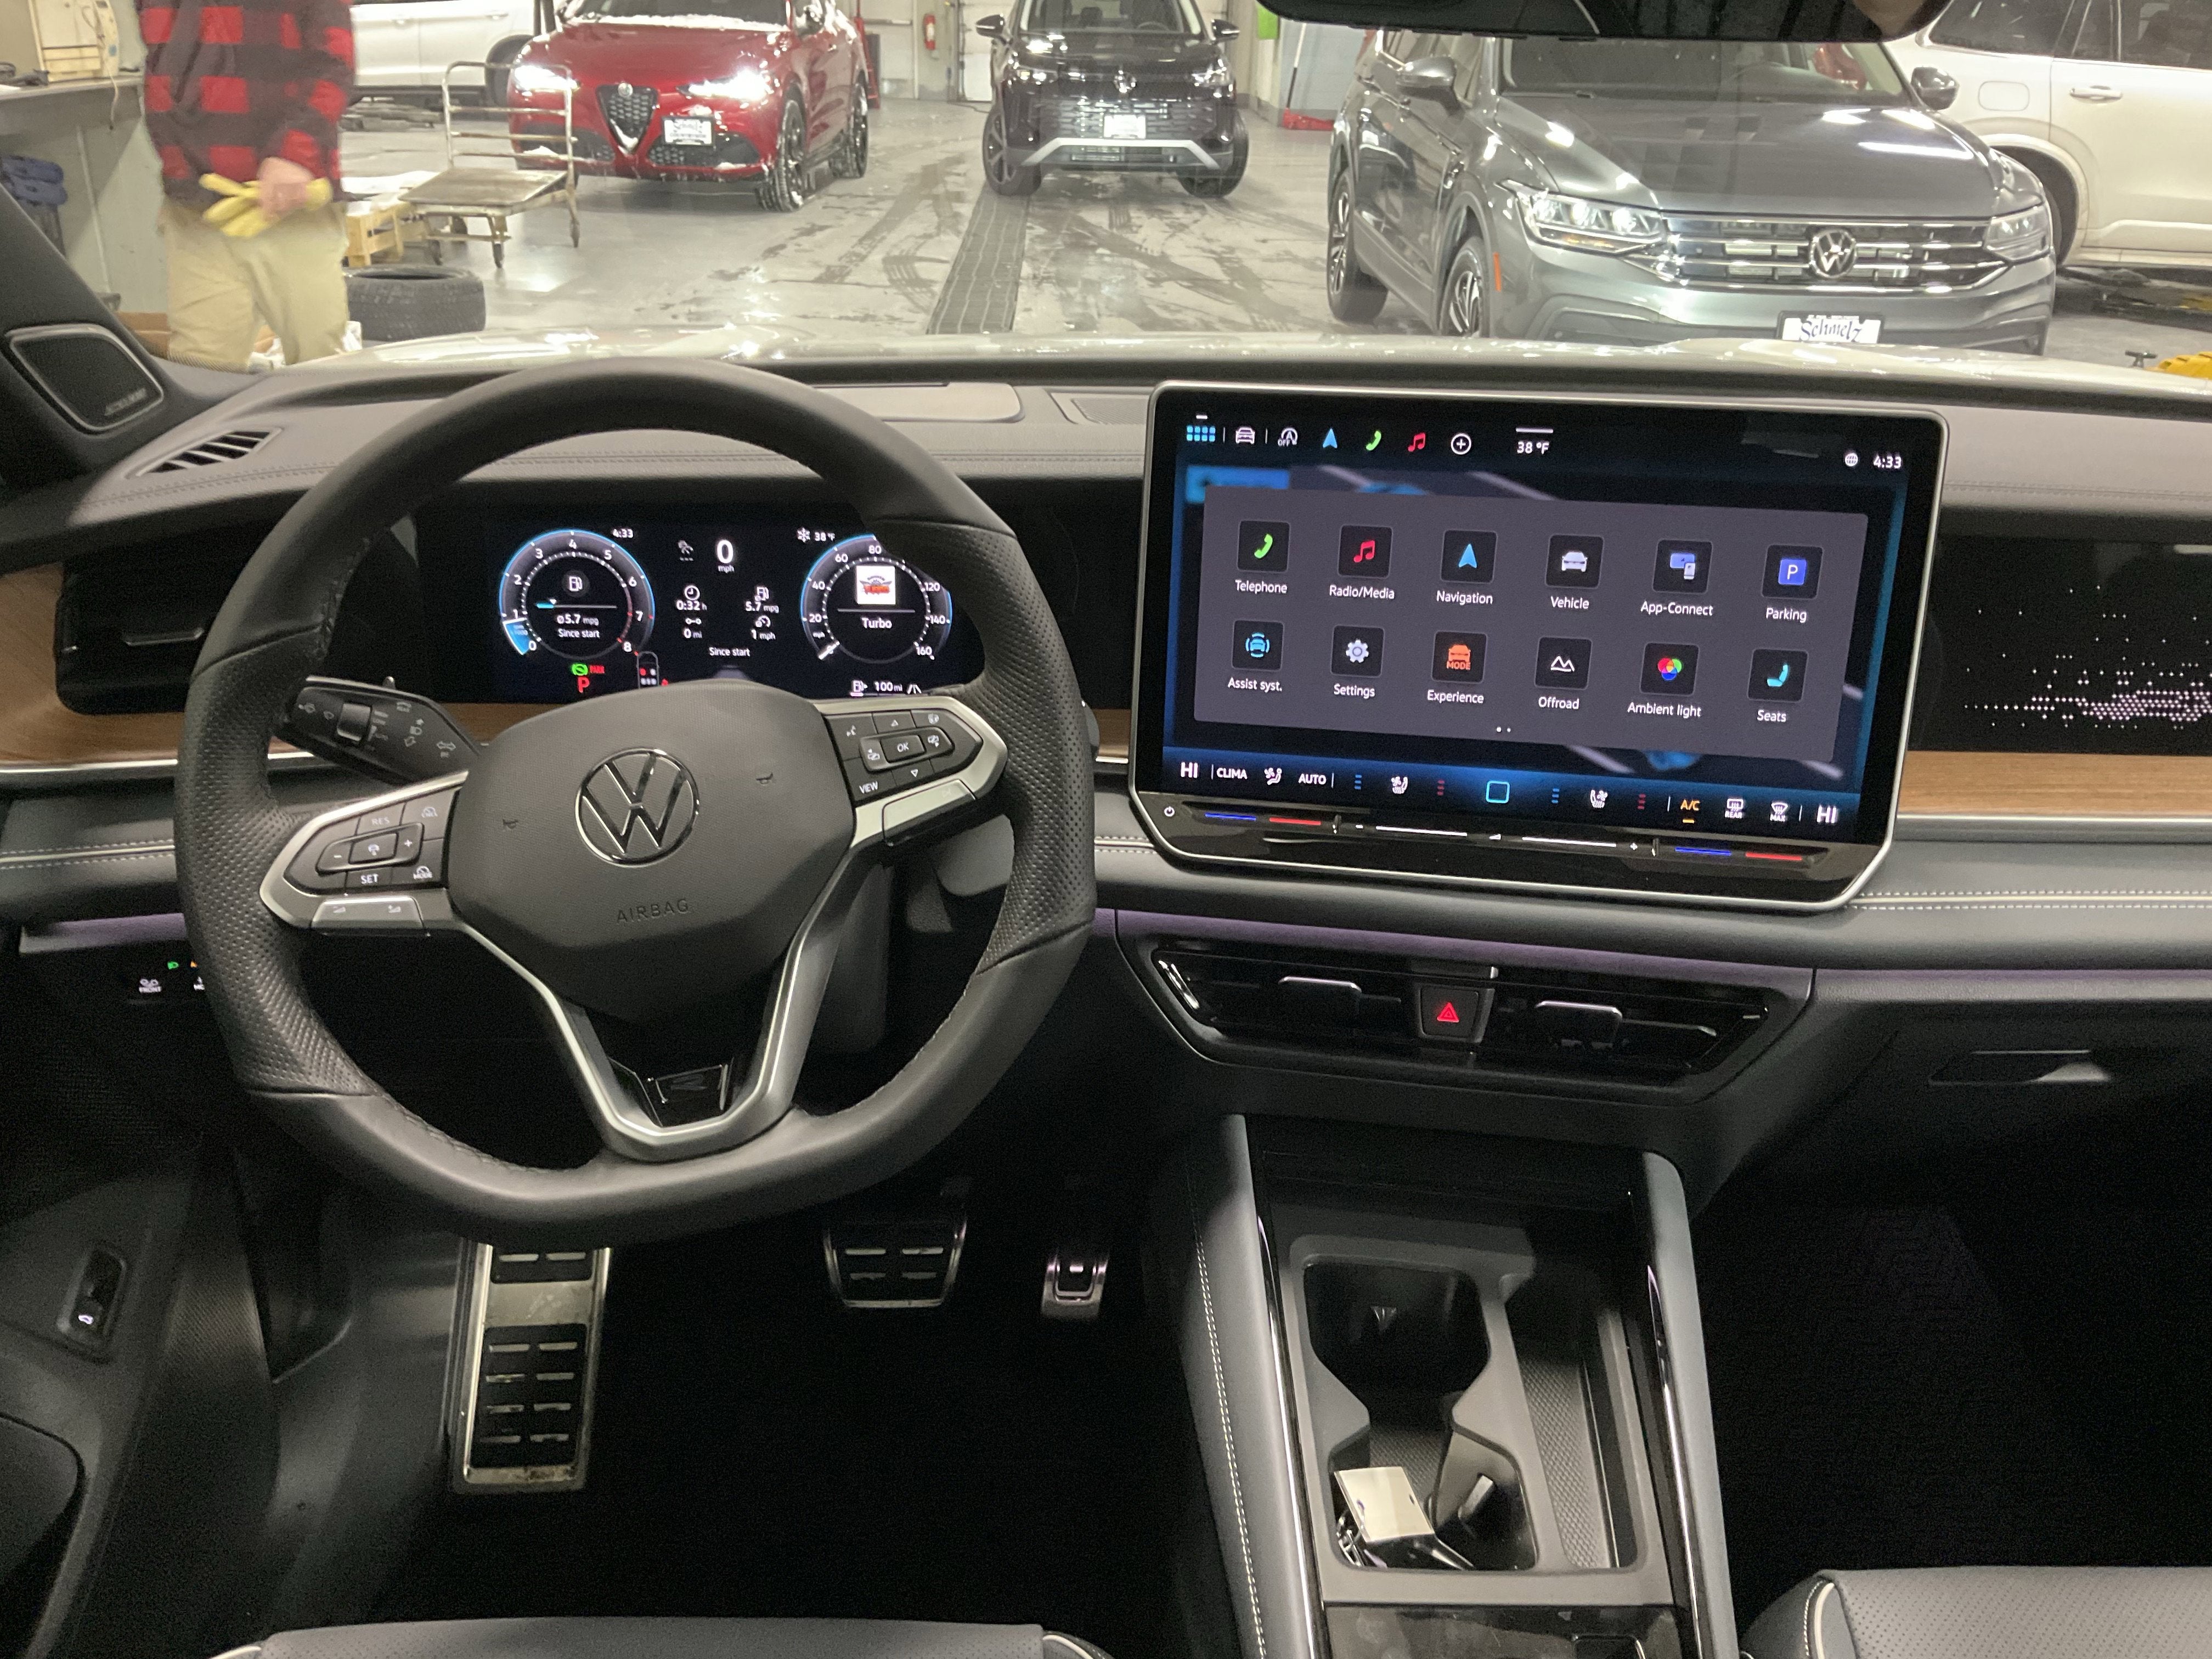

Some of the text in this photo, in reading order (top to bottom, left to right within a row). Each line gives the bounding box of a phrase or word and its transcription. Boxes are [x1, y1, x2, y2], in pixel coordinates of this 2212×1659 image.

[1801, 319, 1861, 342] Schmelz
[1516, 441, 1550, 455] 38 °F
[1873, 455, 1902, 469] 4:33
[612, 529, 634, 538] 4:33
[814, 532, 826, 541] 38
[569, 539, 577, 549] 4
[868, 545, 882, 554] 80
[535, 548, 543, 558] 3
[605, 550, 612, 560] 5
[716, 539, 733, 563] 0
[835, 554, 848, 562] 60
[1787, 565, 1799, 579] P
[514, 574, 522, 585] 2
[629, 577, 637, 587] 6
[812, 581, 826, 590] 40
[925, 582, 940, 591] 120
[1235, 580, 1288, 595] Telephone
[1329, 584, 1395, 601] Radio/Media
[1436, 590, 1493, 605] Navigation
[676, 600, 700, 611] 0:32
[745, 601, 780, 613] 5.7 mpg
[1551, 596, 1589, 610] Vehicle
[1640, 600, 1713, 616] App-Connect
[513, 610, 518, 619] 1
[636, 611, 643, 621] 7
[809, 614, 822, 623] 20
[930, 615, 945, 624] 140
[1766, 607, 1807, 623] Parking
[861, 617, 892, 628] Turbo
[558, 628, 600, 638] Since start
[684, 628, 692, 639] 0
[751, 629, 776, 641] 1 mph
[529, 640, 537, 651] 0
[623, 642, 632, 652] 8
[916, 646, 932, 656] 160
[709, 647, 751, 657] Since start
[1446, 661, 1471, 670] MODE
[578, 676, 590, 693] P
[874, 681, 893, 691] 100
[1227, 677, 1283, 693] Assist syst.
[1334, 684, 1375, 699] Settings
[1427, 690, 1485, 704] Experience
[1538, 696, 1580, 710] Offroad
[1627, 702, 1701, 719] Ambient light
[1757, 710, 1786, 723] Seats
[897, 742, 909, 752] OK
[1180, 761, 1198, 778] HI
[1216, 767, 1248, 780] CLIMA
[1298, 773, 1327, 785] AUTO
[859, 781, 878, 794] VIEW
[1680, 799, 1700, 811] A/C
[1816, 805, 1837, 823] HI
[371, 817, 390, 825] RES
[360, 874, 379, 884] SET
[617, 899, 689, 923] AIRBAG
